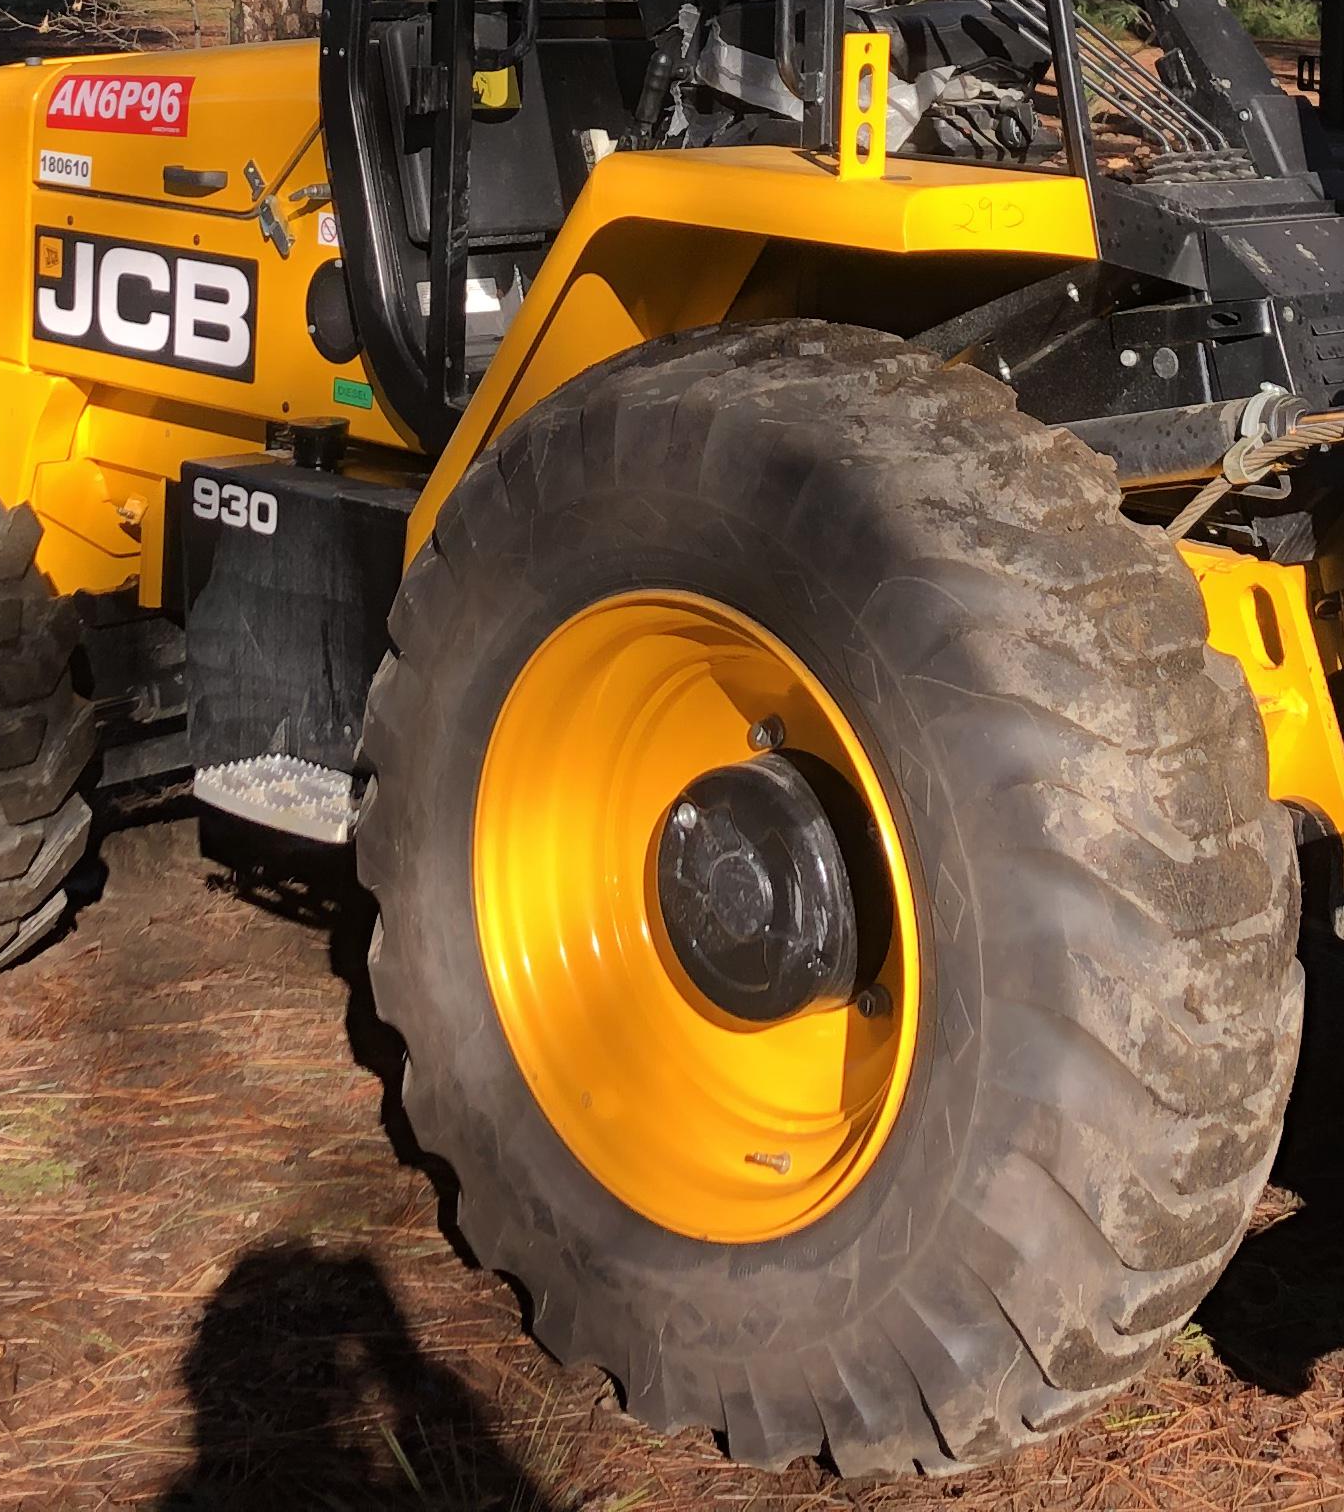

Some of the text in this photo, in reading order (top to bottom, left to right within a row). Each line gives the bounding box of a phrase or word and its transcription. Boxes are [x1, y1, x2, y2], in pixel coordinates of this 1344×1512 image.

[48, 79, 183, 123] AN6P96
[41, 154, 89, 178] 180610
[38, 241, 251, 367] JCB
[336, 385, 369, 402] DIESEL
[192, 476, 278, 536] 930
